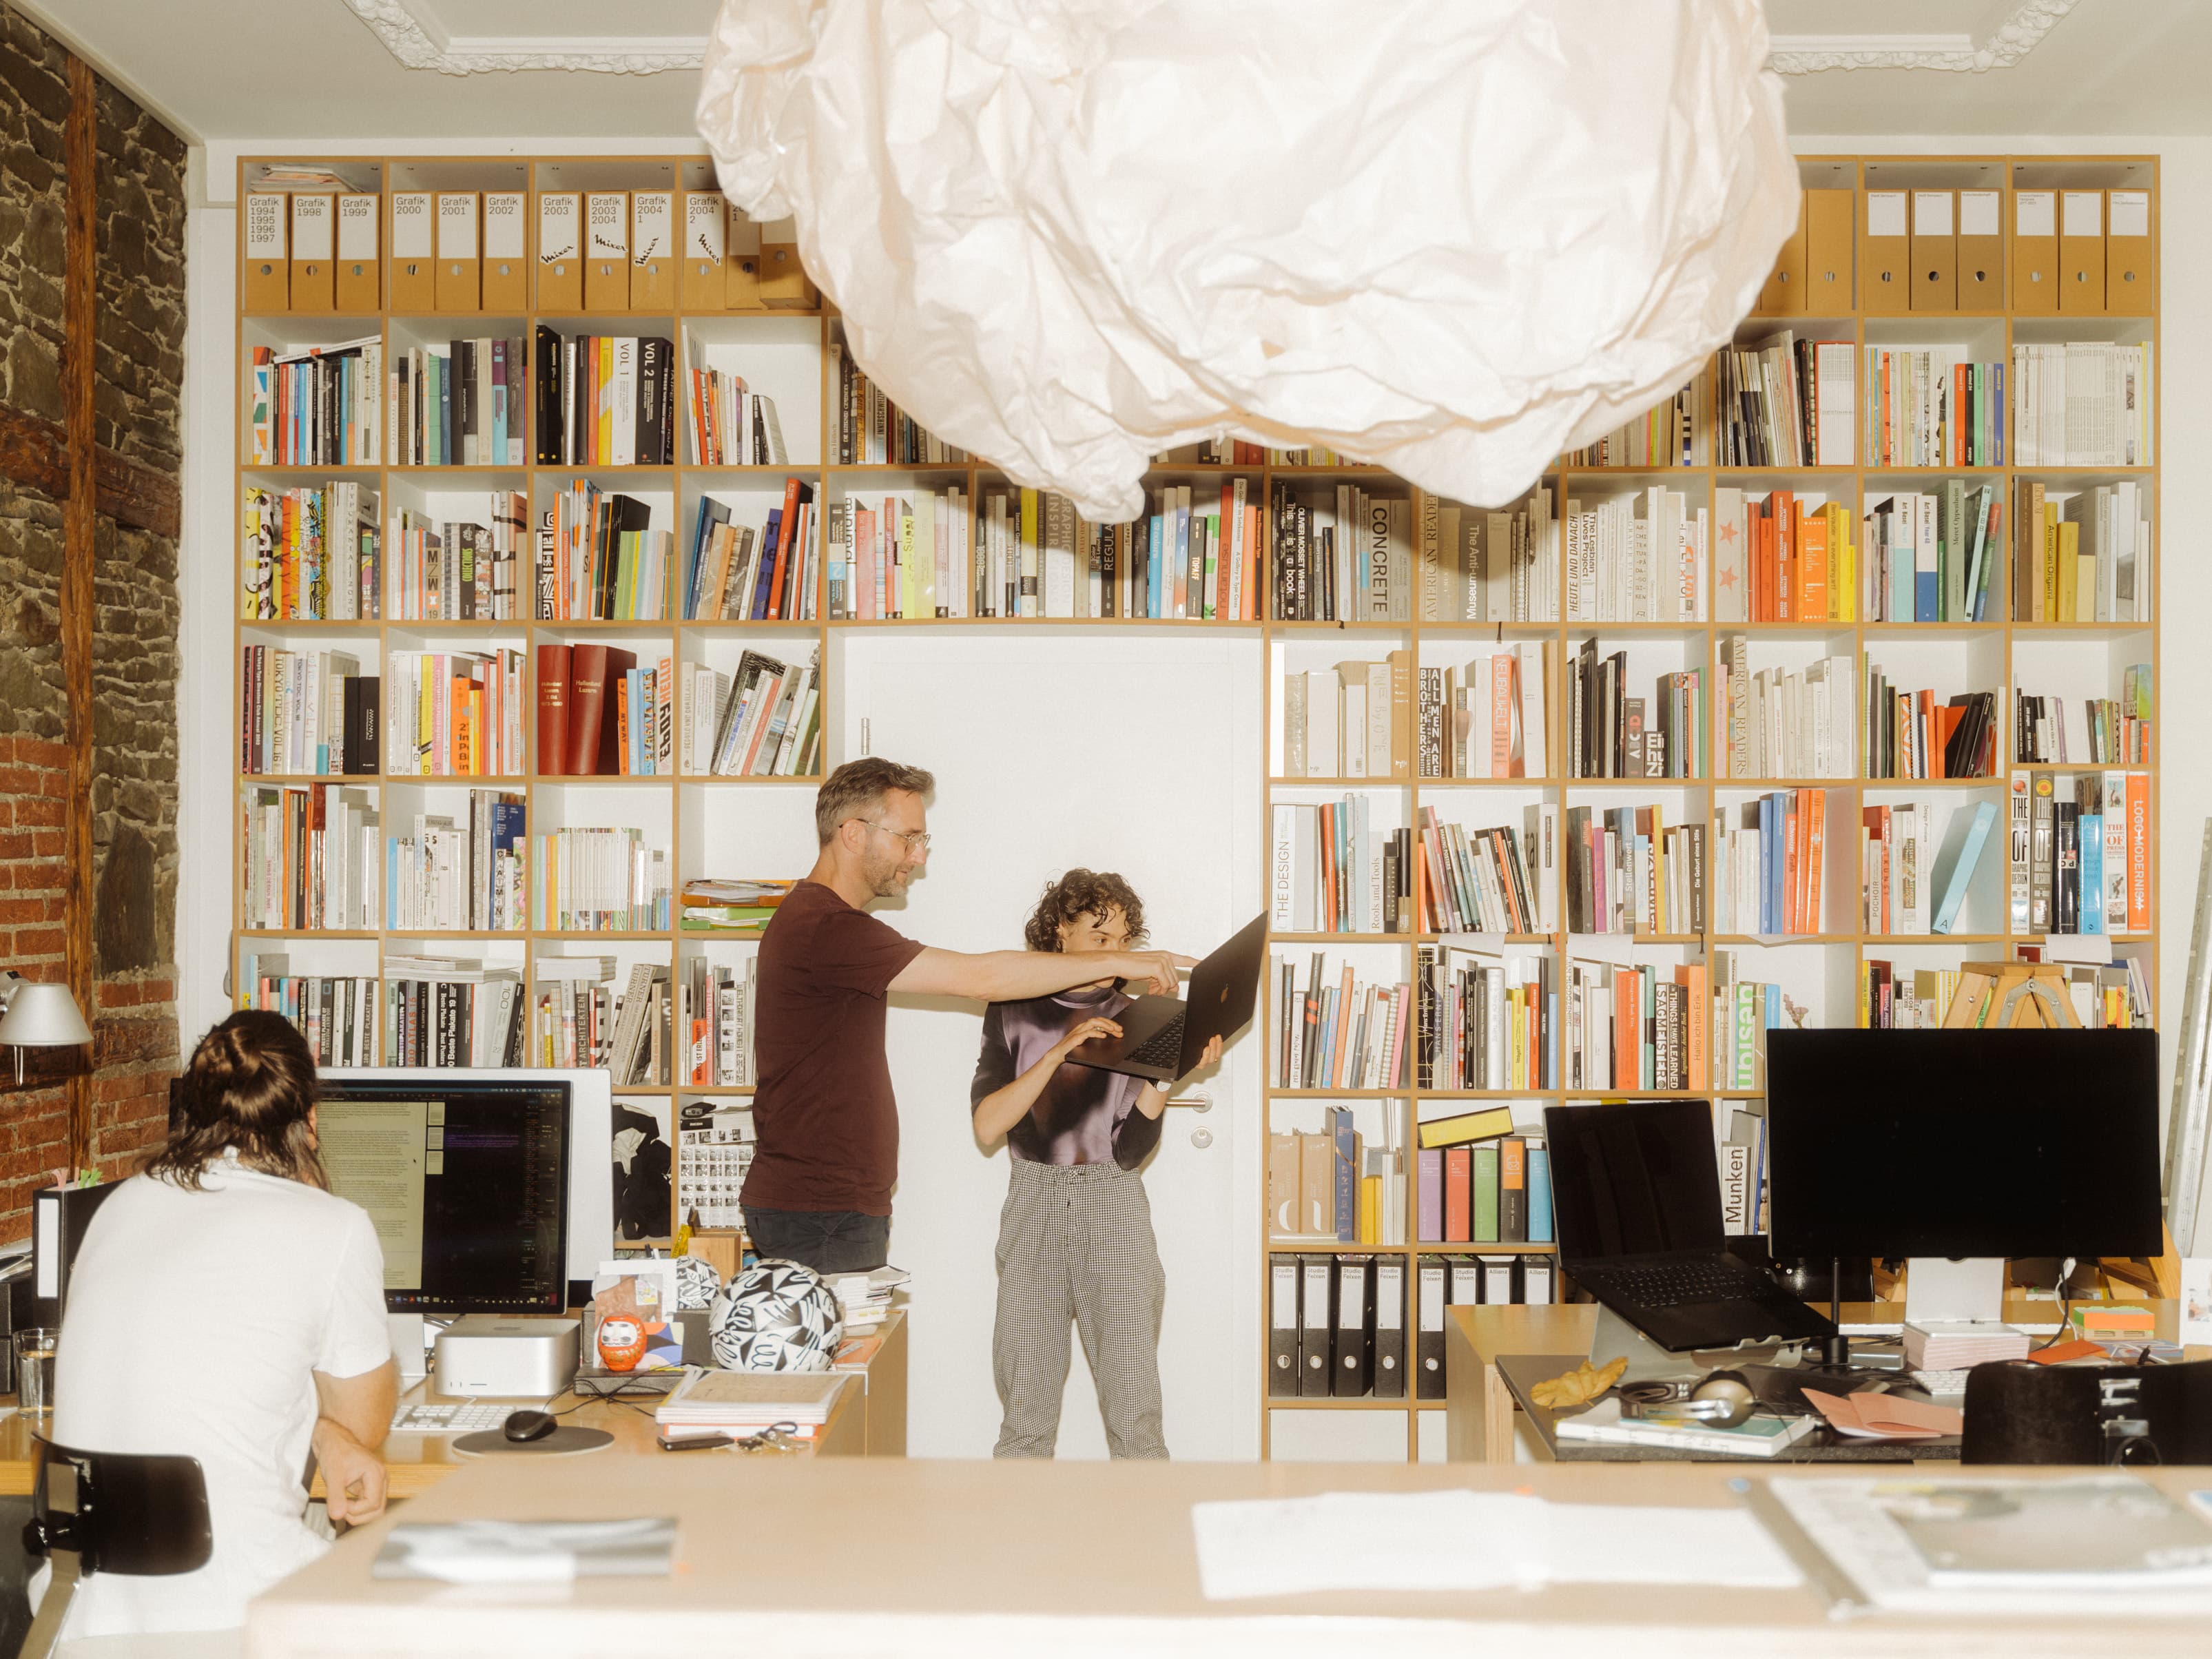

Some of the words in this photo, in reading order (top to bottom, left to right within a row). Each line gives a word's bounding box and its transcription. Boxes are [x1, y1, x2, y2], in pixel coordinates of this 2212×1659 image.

[250, 198, 279, 206] Grafik
[297, 198, 326, 207] Grafik
[342, 199, 371, 207] Grafik
[396, 197, 425, 205] Grafik
[396, 206, 422, 214] 2000
[442, 198, 471, 206] Grafik
[442, 207, 466, 215] 2001
[488, 198, 518, 206] Grafik
[489, 207, 514, 215] 2002
[544, 198, 573, 206] Grafik
[544, 207, 568, 215] 2003
[592, 198, 621, 206] Grafik
[592, 207, 617, 215] 2003
[637, 197, 667, 205] Grafik
[637, 206, 662, 214] 2004
[690, 197, 719, 206] Grafik
[690, 207, 714, 215] 2004
[250, 207, 275, 216] 1994
[251, 216, 275, 225] 1995
[297, 208, 321, 216] 1998
[342, 208, 367, 216] 1999
[592, 216, 617, 224] 2004
[638, 215, 643, 223] 1
[690, 216, 695, 224] 2
[251, 225, 275, 234] 1996
[251, 234, 275, 243] 1997
[620, 343, 629, 366] VOL
[645, 342, 654, 366] VOL
[1953, 488, 1961, 525] Oppenheim
[846, 498, 856, 565] minimal
[1469, 525, 1479, 545] The
[1569, 515, 1578, 555] DANACH
[462, 548, 473, 582] COLLECTIONS
[1372, 508, 1387, 612] CONCRETE
[1569, 558, 1578, 579] UND
[1217, 543, 1230, 608] notamuse
[1427, 548, 1436, 618] AMERICAN
[2046, 566, 2054, 599] Origami
[1467, 572, 1476, 619] Museum
[1569, 581, 1578, 612] HEUTE
[428, 610, 438, 619] 19
[659, 658, 670, 704] HELLO
[1735, 640, 1746, 710] AMERICAN
[1496, 658, 1508, 728] NEUBAUWELT
[1419, 669, 1428, 755] BROTHERS
[1735, 717, 1746, 775] READERS
[2013, 798, 2027, 814] THE
[2036, 797, 2051, 818] THE
[2134, 799, 2144, 832] LOGO
[2012, 830, 2027, 862] OF
[2035, 830, 2051, 861] OF
[2107, 836, 2125, 845] OF
[1277, 841, 1290, 889] DESIGN
[1371, 857, 1380, 883] Tools
[1443, 849, 1451, 871] POSTERS
[2012, 864, 2027, 872] GRAPHIC
[2012, 874, 2027, 885] DESIGN
[2134, 836, 2144, 909] MODERNISM
[1371, 885, 1380, 900] und
[1276, 894, 1289, 920] THE
[1940, 919, 1948, 929] A
[626, 967, 641, 1003] TURNER
[636, 967, 651, 1003] TURNER
[448, 999, 456, 1008] 19
[500, 986, 511, 1009] 100
[1669, 991, 1677, 1022] THINGS
[1657, 990, 1666, 1078] SAGMEISTER
[1670, 1044, 1678, 1089] LEARNED
[1725, 1149, 1743, 1223] Munken
